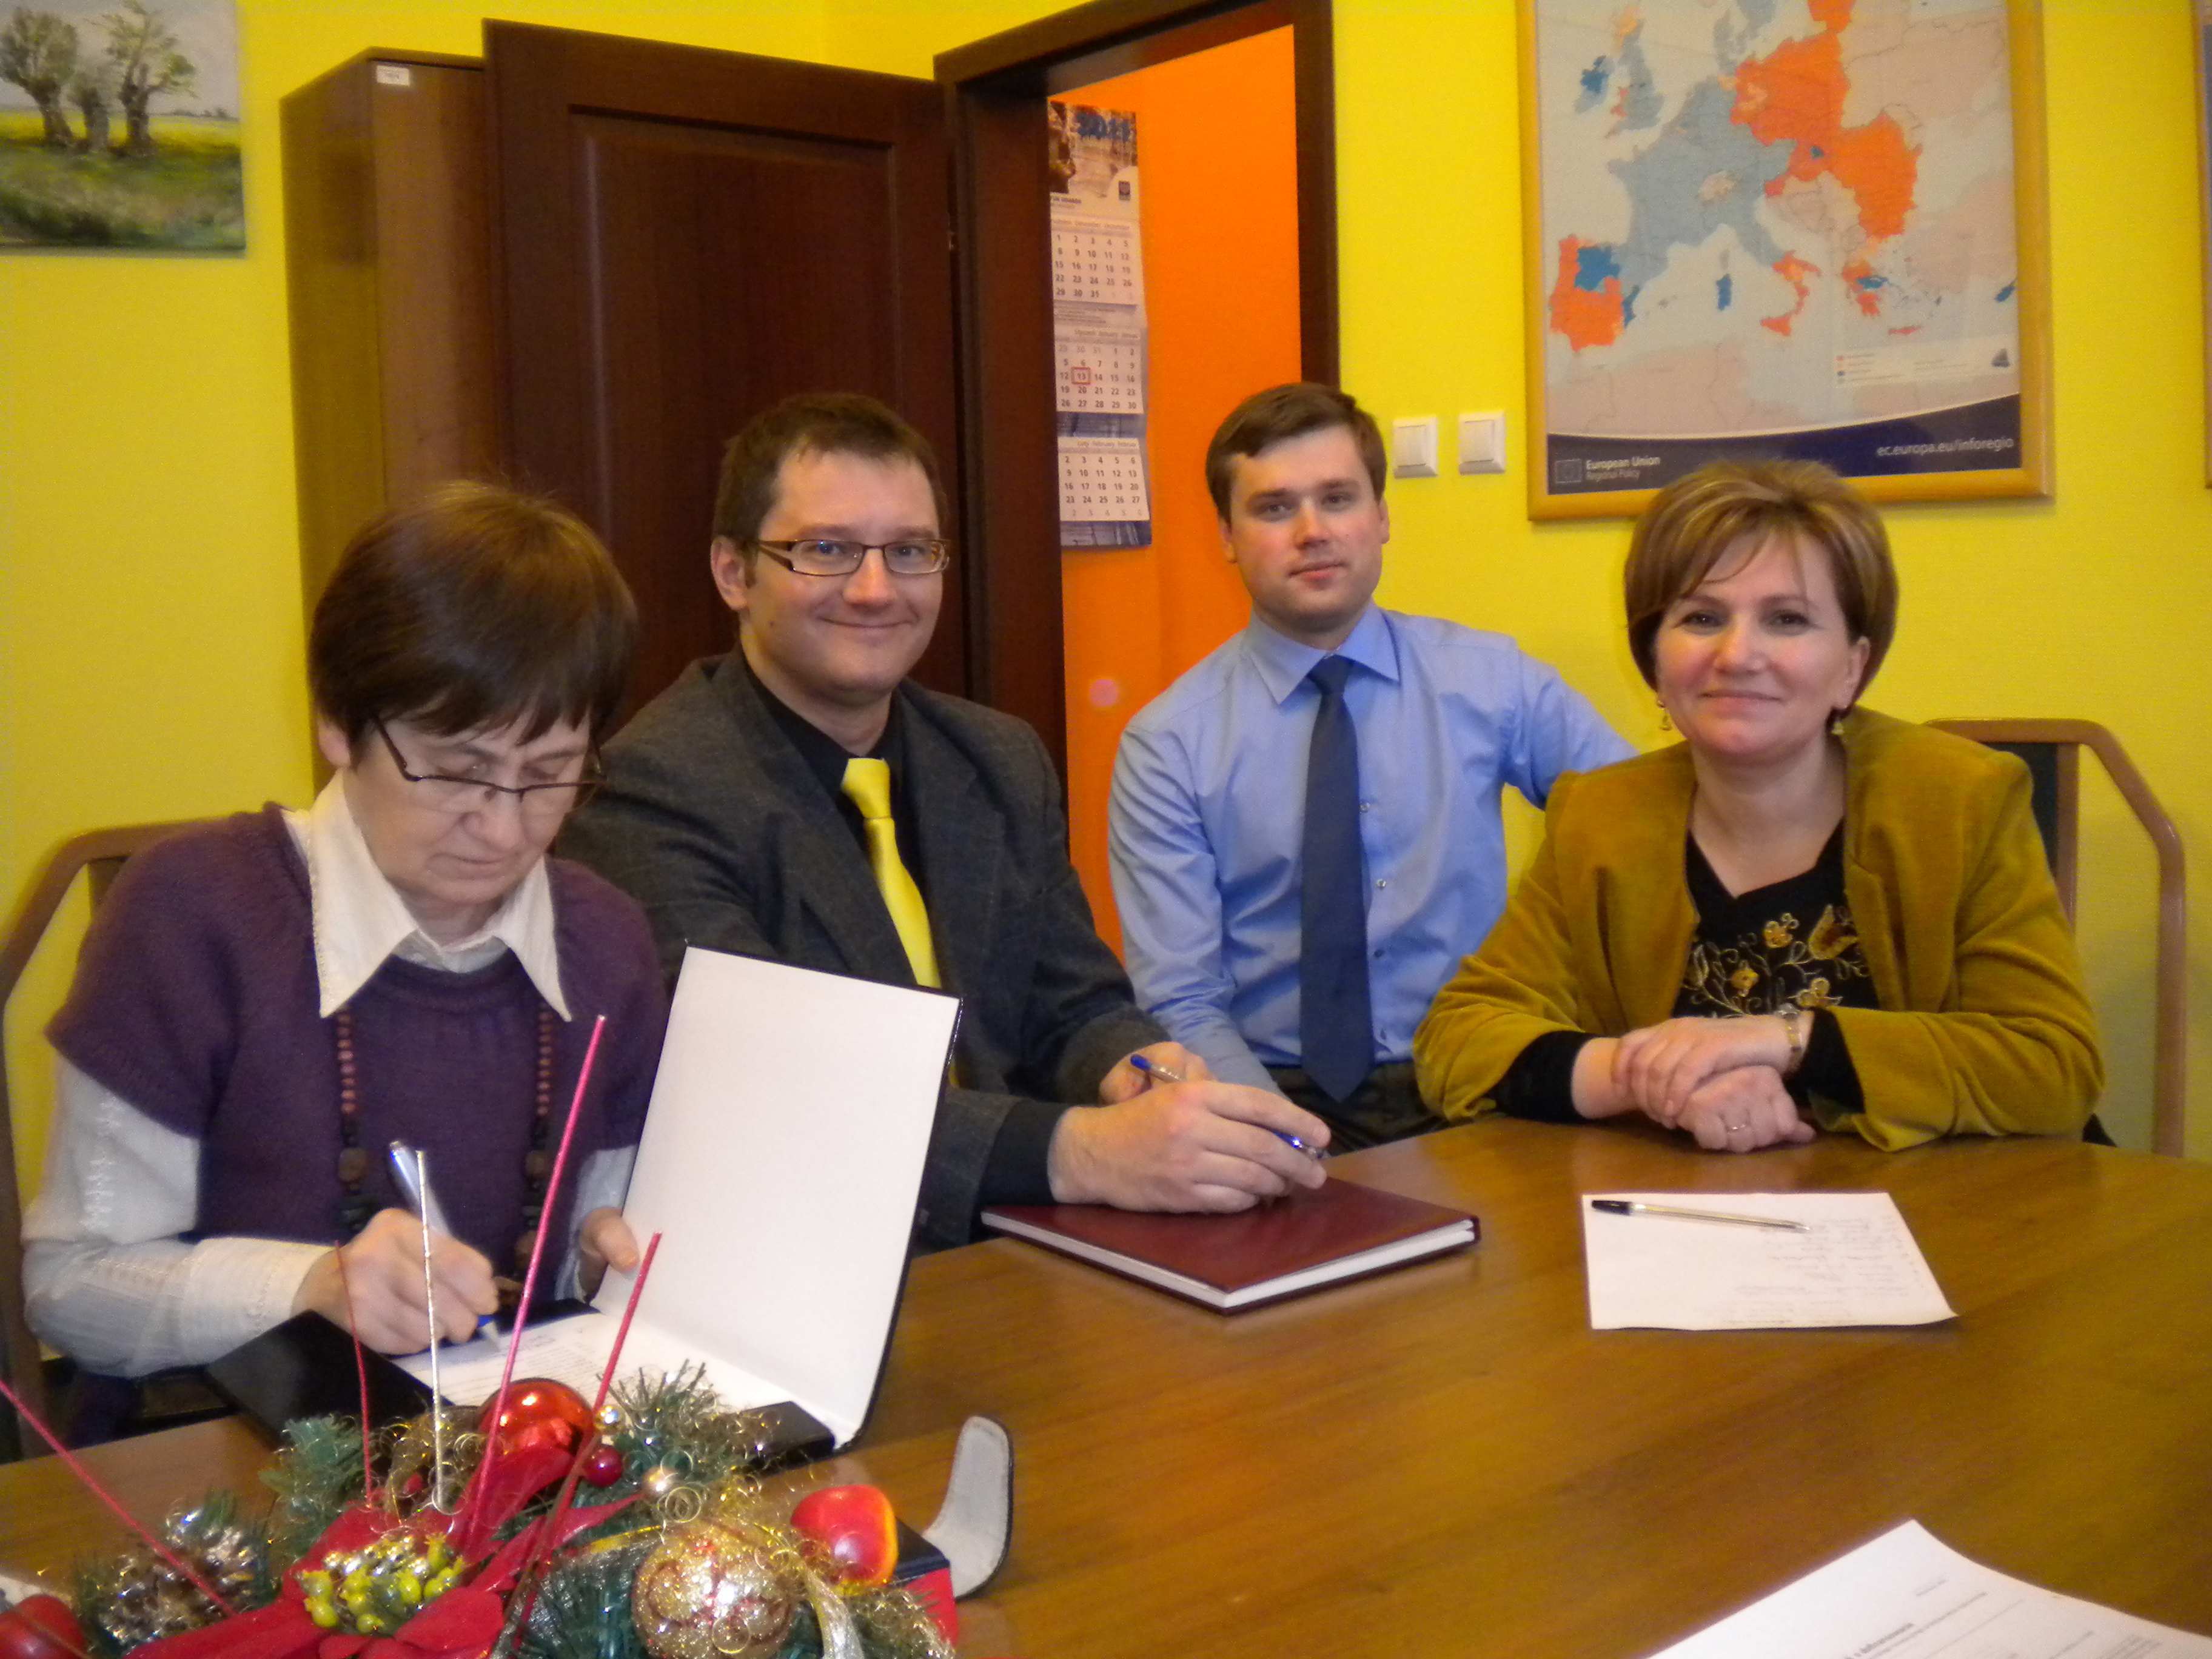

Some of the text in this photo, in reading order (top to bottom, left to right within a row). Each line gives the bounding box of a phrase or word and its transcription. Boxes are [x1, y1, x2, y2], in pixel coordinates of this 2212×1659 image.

[1877, 437, 2014, 456] ec.europa.eu/inforegio
[1586, 456, 1661, 470] European Union
